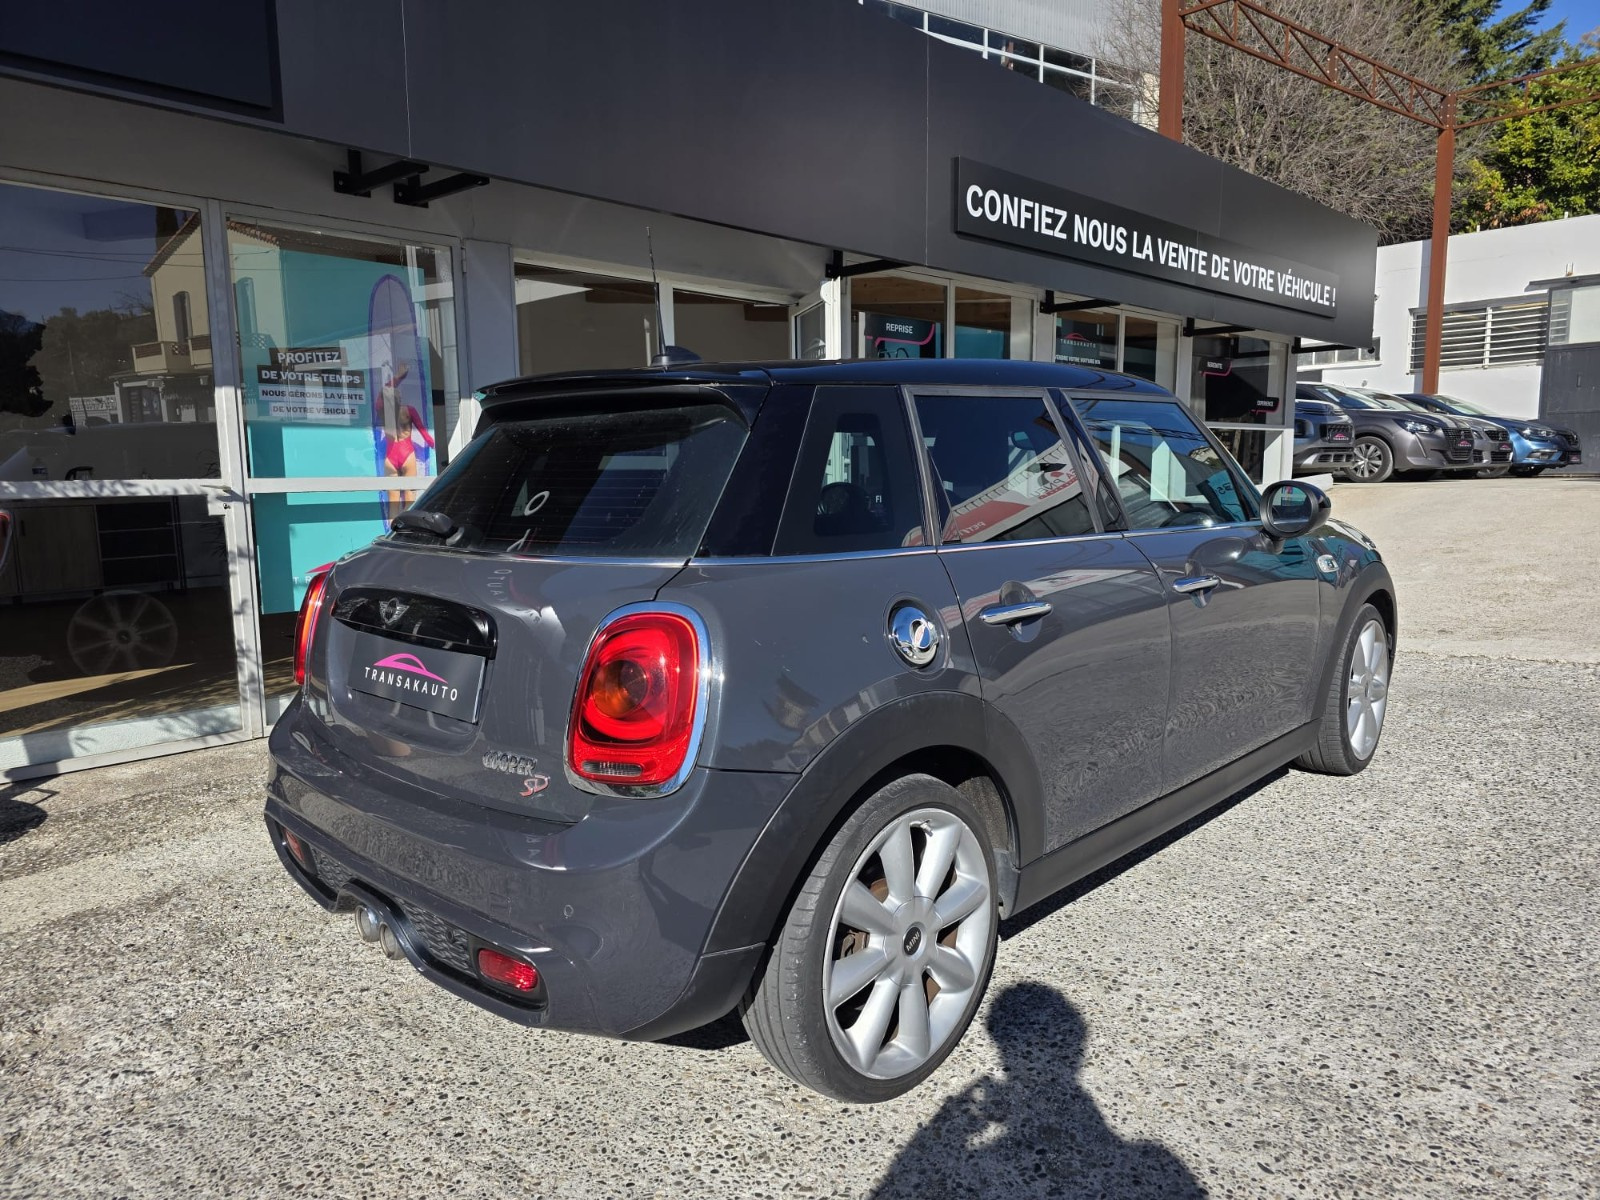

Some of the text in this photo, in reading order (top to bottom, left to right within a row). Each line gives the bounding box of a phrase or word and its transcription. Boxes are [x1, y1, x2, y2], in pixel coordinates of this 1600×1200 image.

[966, 184, 1067, 239] CONFIEZ
[1074, 213, 1127, 254] NOUS
[1132, 230, 1153, 261] LA
[1157, 237, 1207, 275] VENTE
[1211, 253, 1230, 281] DE
[1233, 259, 1275, 291] VOTRE
[1277, 268, 1330, 306] VÉHICULE
[885, 322, 913, 334] REPRISE
[277, 351, 341, 364] PROFITEZ
[261, 370, 361, 384] DE VOTRE TEMPS
[261, 389, 286, 398] NOUS
[325, 392, 335, 400] LA
[337, 393, 364, 401] VENTE
[273, 405, 285, 413] DE
[286, 406, 315, 414] VOTRE
[364, 666, 458, 701] TRANSAKAUTO
[482, 751, 537, 777] COOPER
[906, 931, 919, 951] MINI
